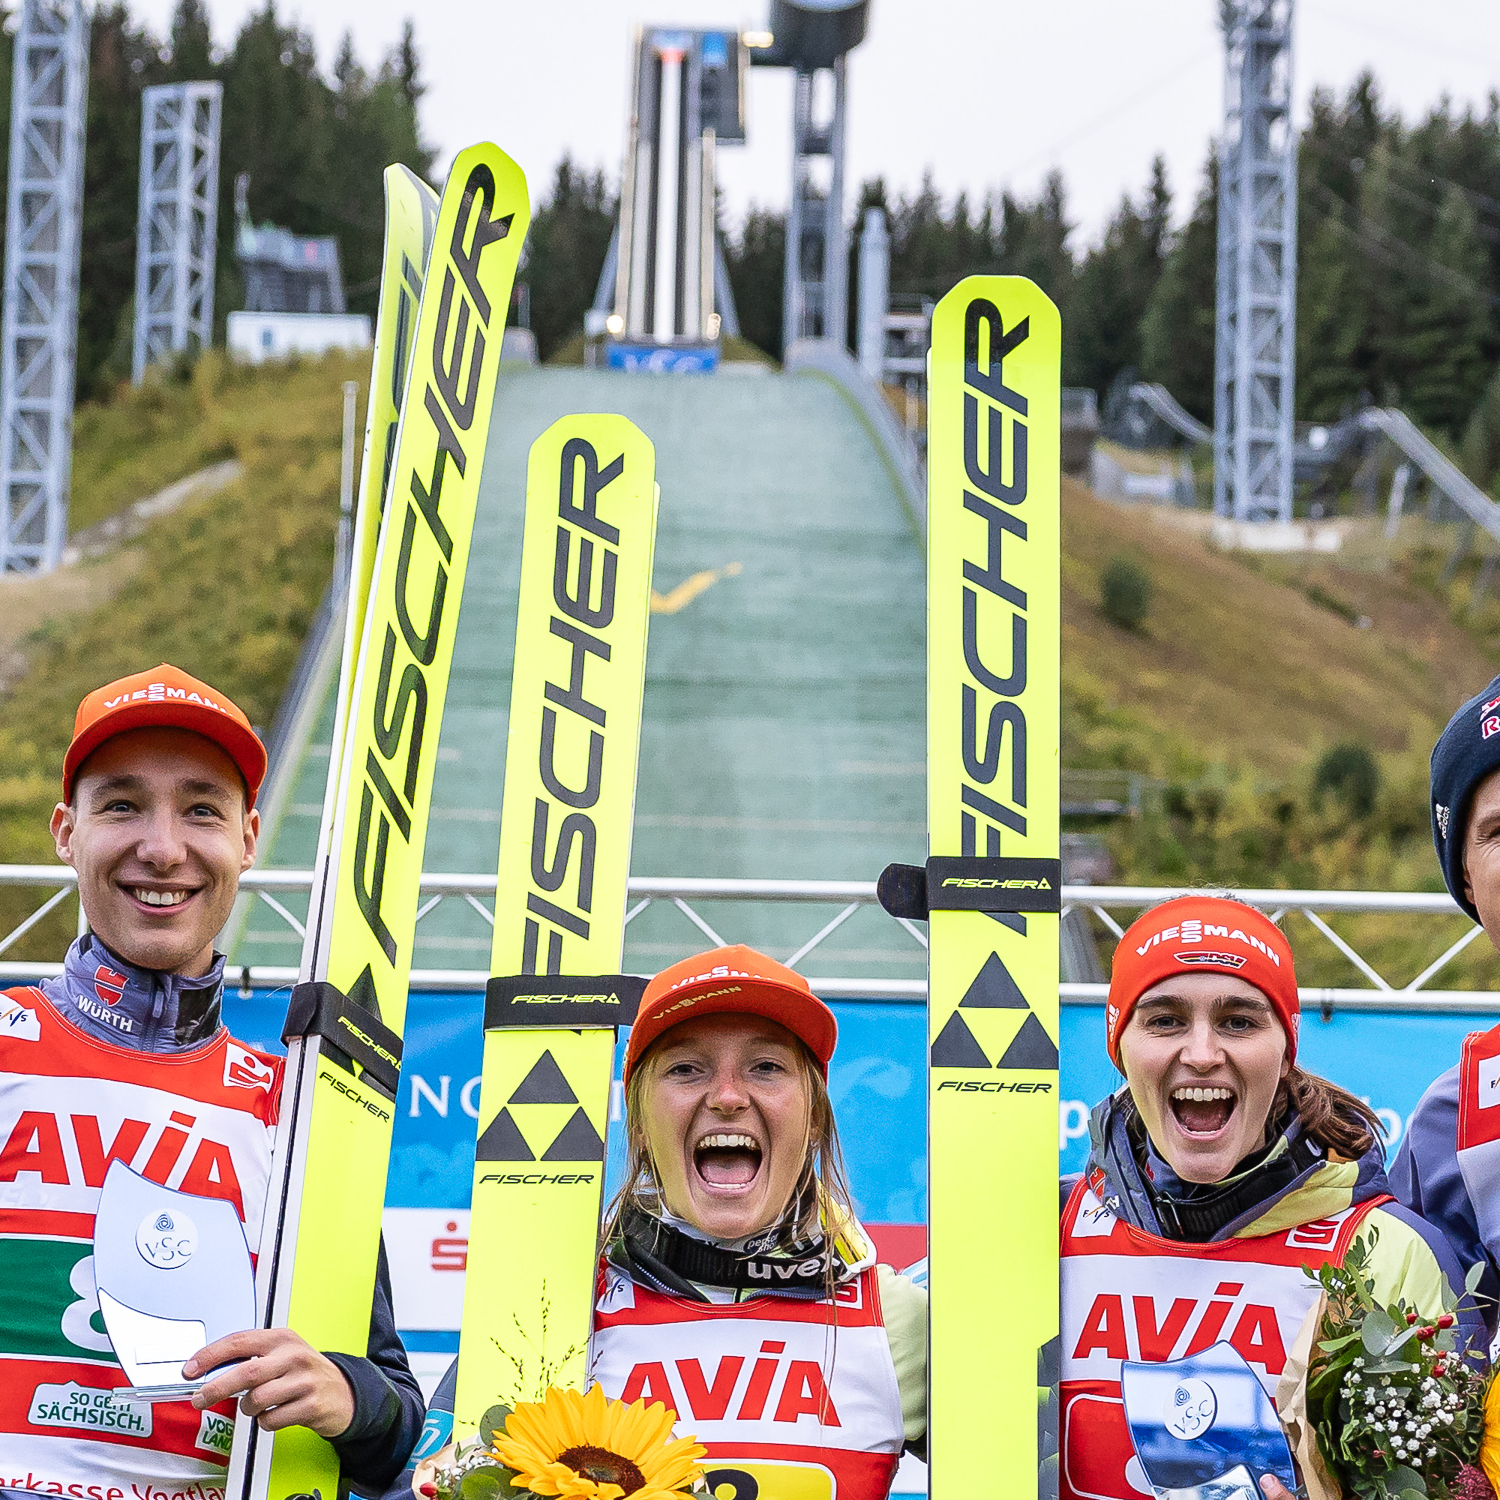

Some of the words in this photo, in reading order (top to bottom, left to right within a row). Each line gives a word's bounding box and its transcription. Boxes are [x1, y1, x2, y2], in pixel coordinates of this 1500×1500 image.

[353, 163, 516, 968] FISCHER
[961, 297, 1031, 938] FISCHER
[522, 437, 625, 974] FISCHER
[941, 879, 1040, 890] FISCHER
[1136, 920, 1280, 967] VIESSMANN
[77, 995, 134, 1033] WÜRTH
[510, 992, 609, 1005] FISCHER
[337, 1014, 399, 1069] FISCHER
[320, 1071, 391, 1123] FISCHER
[938, 1081, 1052, 1095] FISCHER
[478, 1173, 595, 1185] FISCHER
[69, 1391, 90, 1405] SO
[36, 1401, 146, 1432] SÄCHSISCH.
[206, 1413, 234, 1435] VOG
